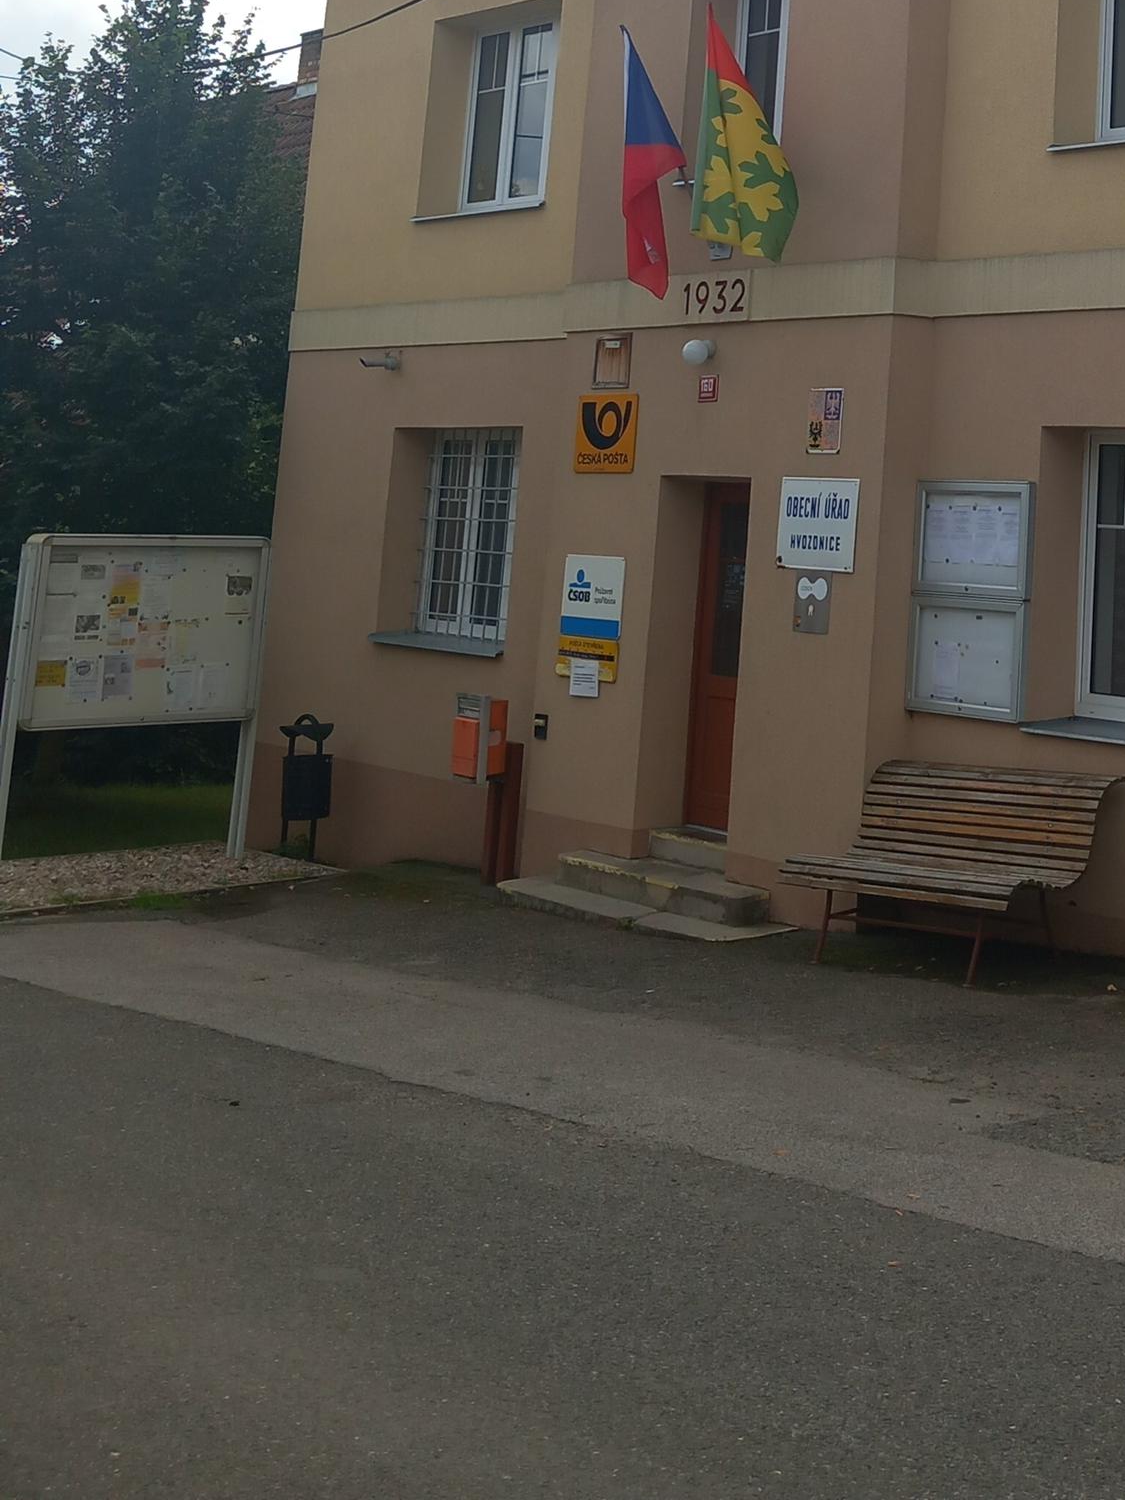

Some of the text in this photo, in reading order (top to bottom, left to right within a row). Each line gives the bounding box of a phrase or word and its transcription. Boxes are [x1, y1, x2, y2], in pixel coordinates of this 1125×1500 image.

[683, 278, 746, 315] 1932
[577, 451, 628, 465] ČESKÁ POŠTA
[786, 492, 850, 520] OBECNÍ ÚŘAD
[790, 534, 841, 552] HVOZDNICE
[568, 588, 591, 602] ČSOB
